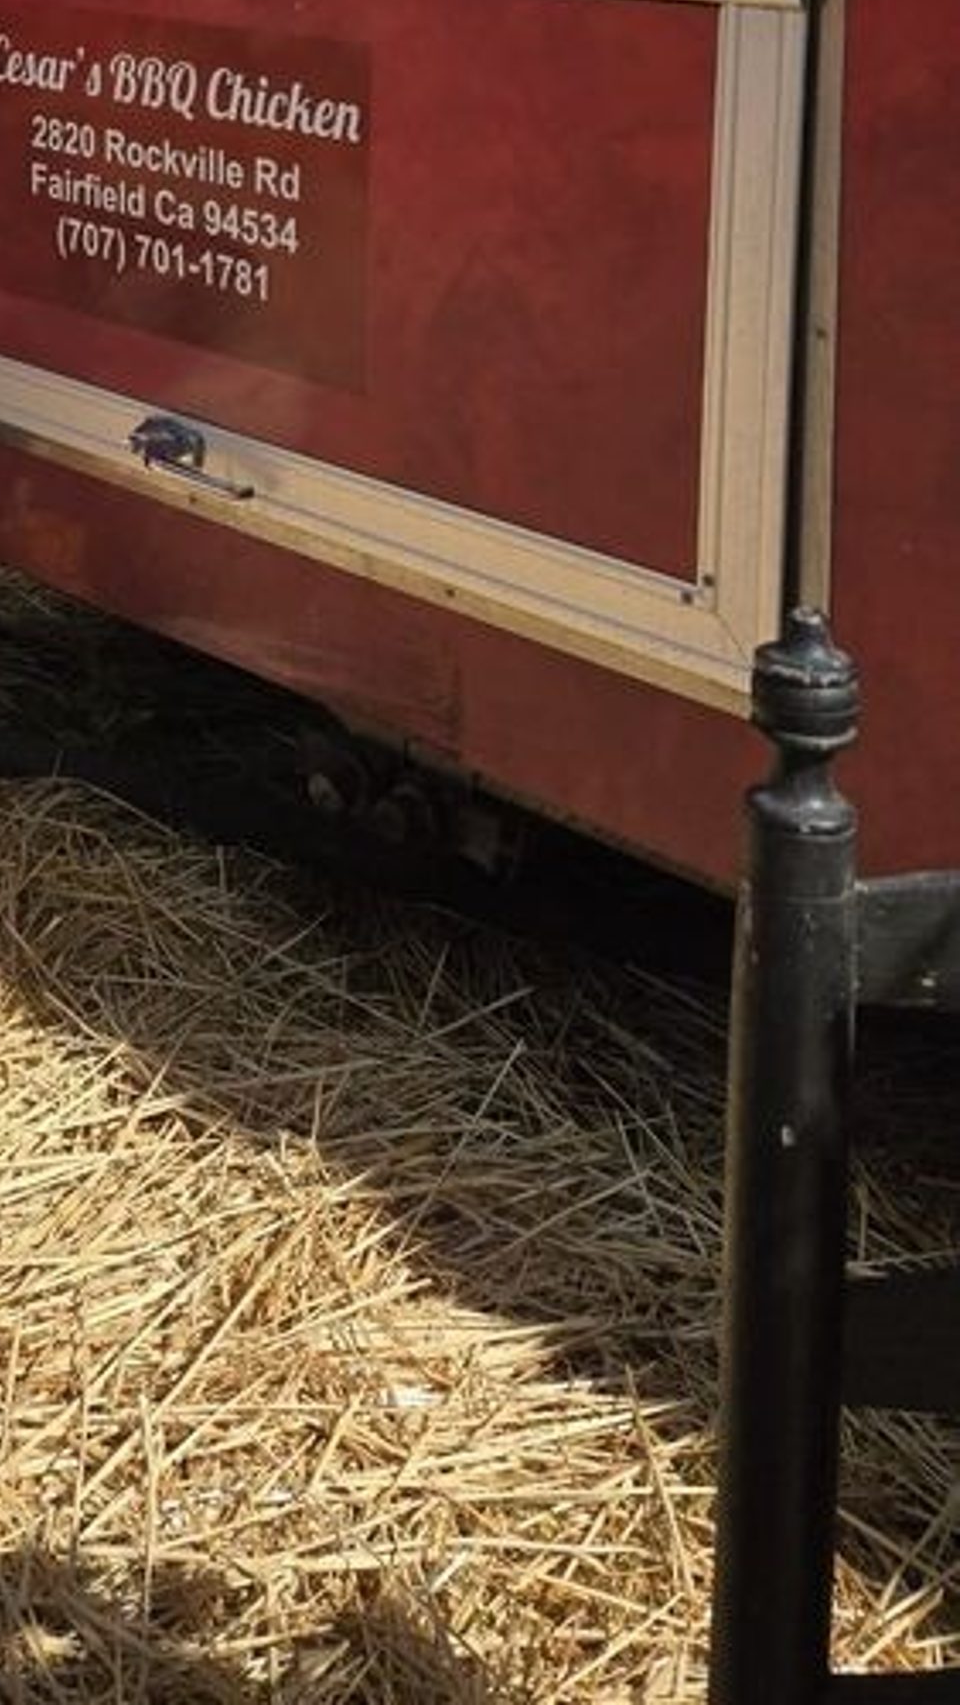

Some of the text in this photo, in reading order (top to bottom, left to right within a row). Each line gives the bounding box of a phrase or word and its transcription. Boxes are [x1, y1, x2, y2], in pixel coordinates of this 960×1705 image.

[110, 53, 198, 121] BBQ
[206, 66, 361, 143] Chicken
[31, 115, 300, 201] 2820 Rockville Rd
[31, 162, 299, 254] Fairfield Ca 94534
[57, 217, 270, 300] (707) 701-1781
